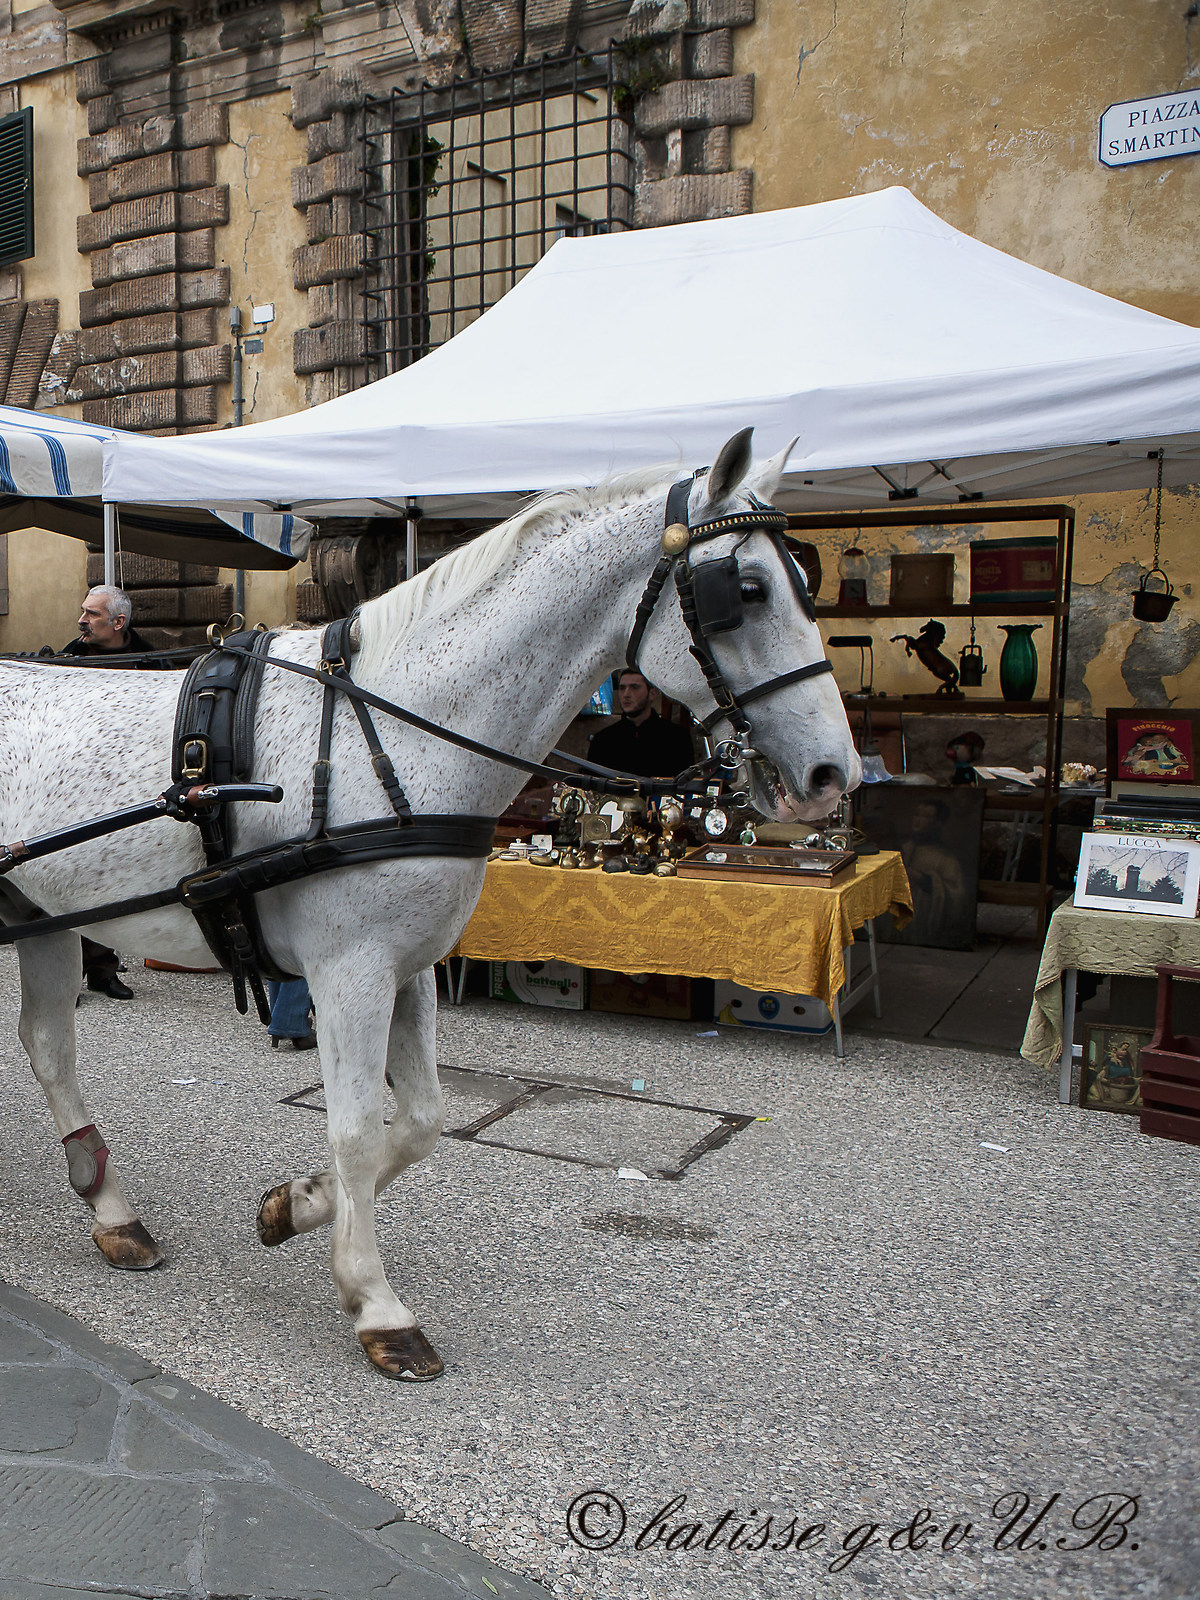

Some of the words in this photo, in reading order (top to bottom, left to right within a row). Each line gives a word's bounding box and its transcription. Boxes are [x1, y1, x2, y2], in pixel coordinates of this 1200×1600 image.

[1128, 100, 1200, 128] PIAZZA
[1118, 837, 1161, 848] LUCCA
[526, 974, 578, 989] battaglio
